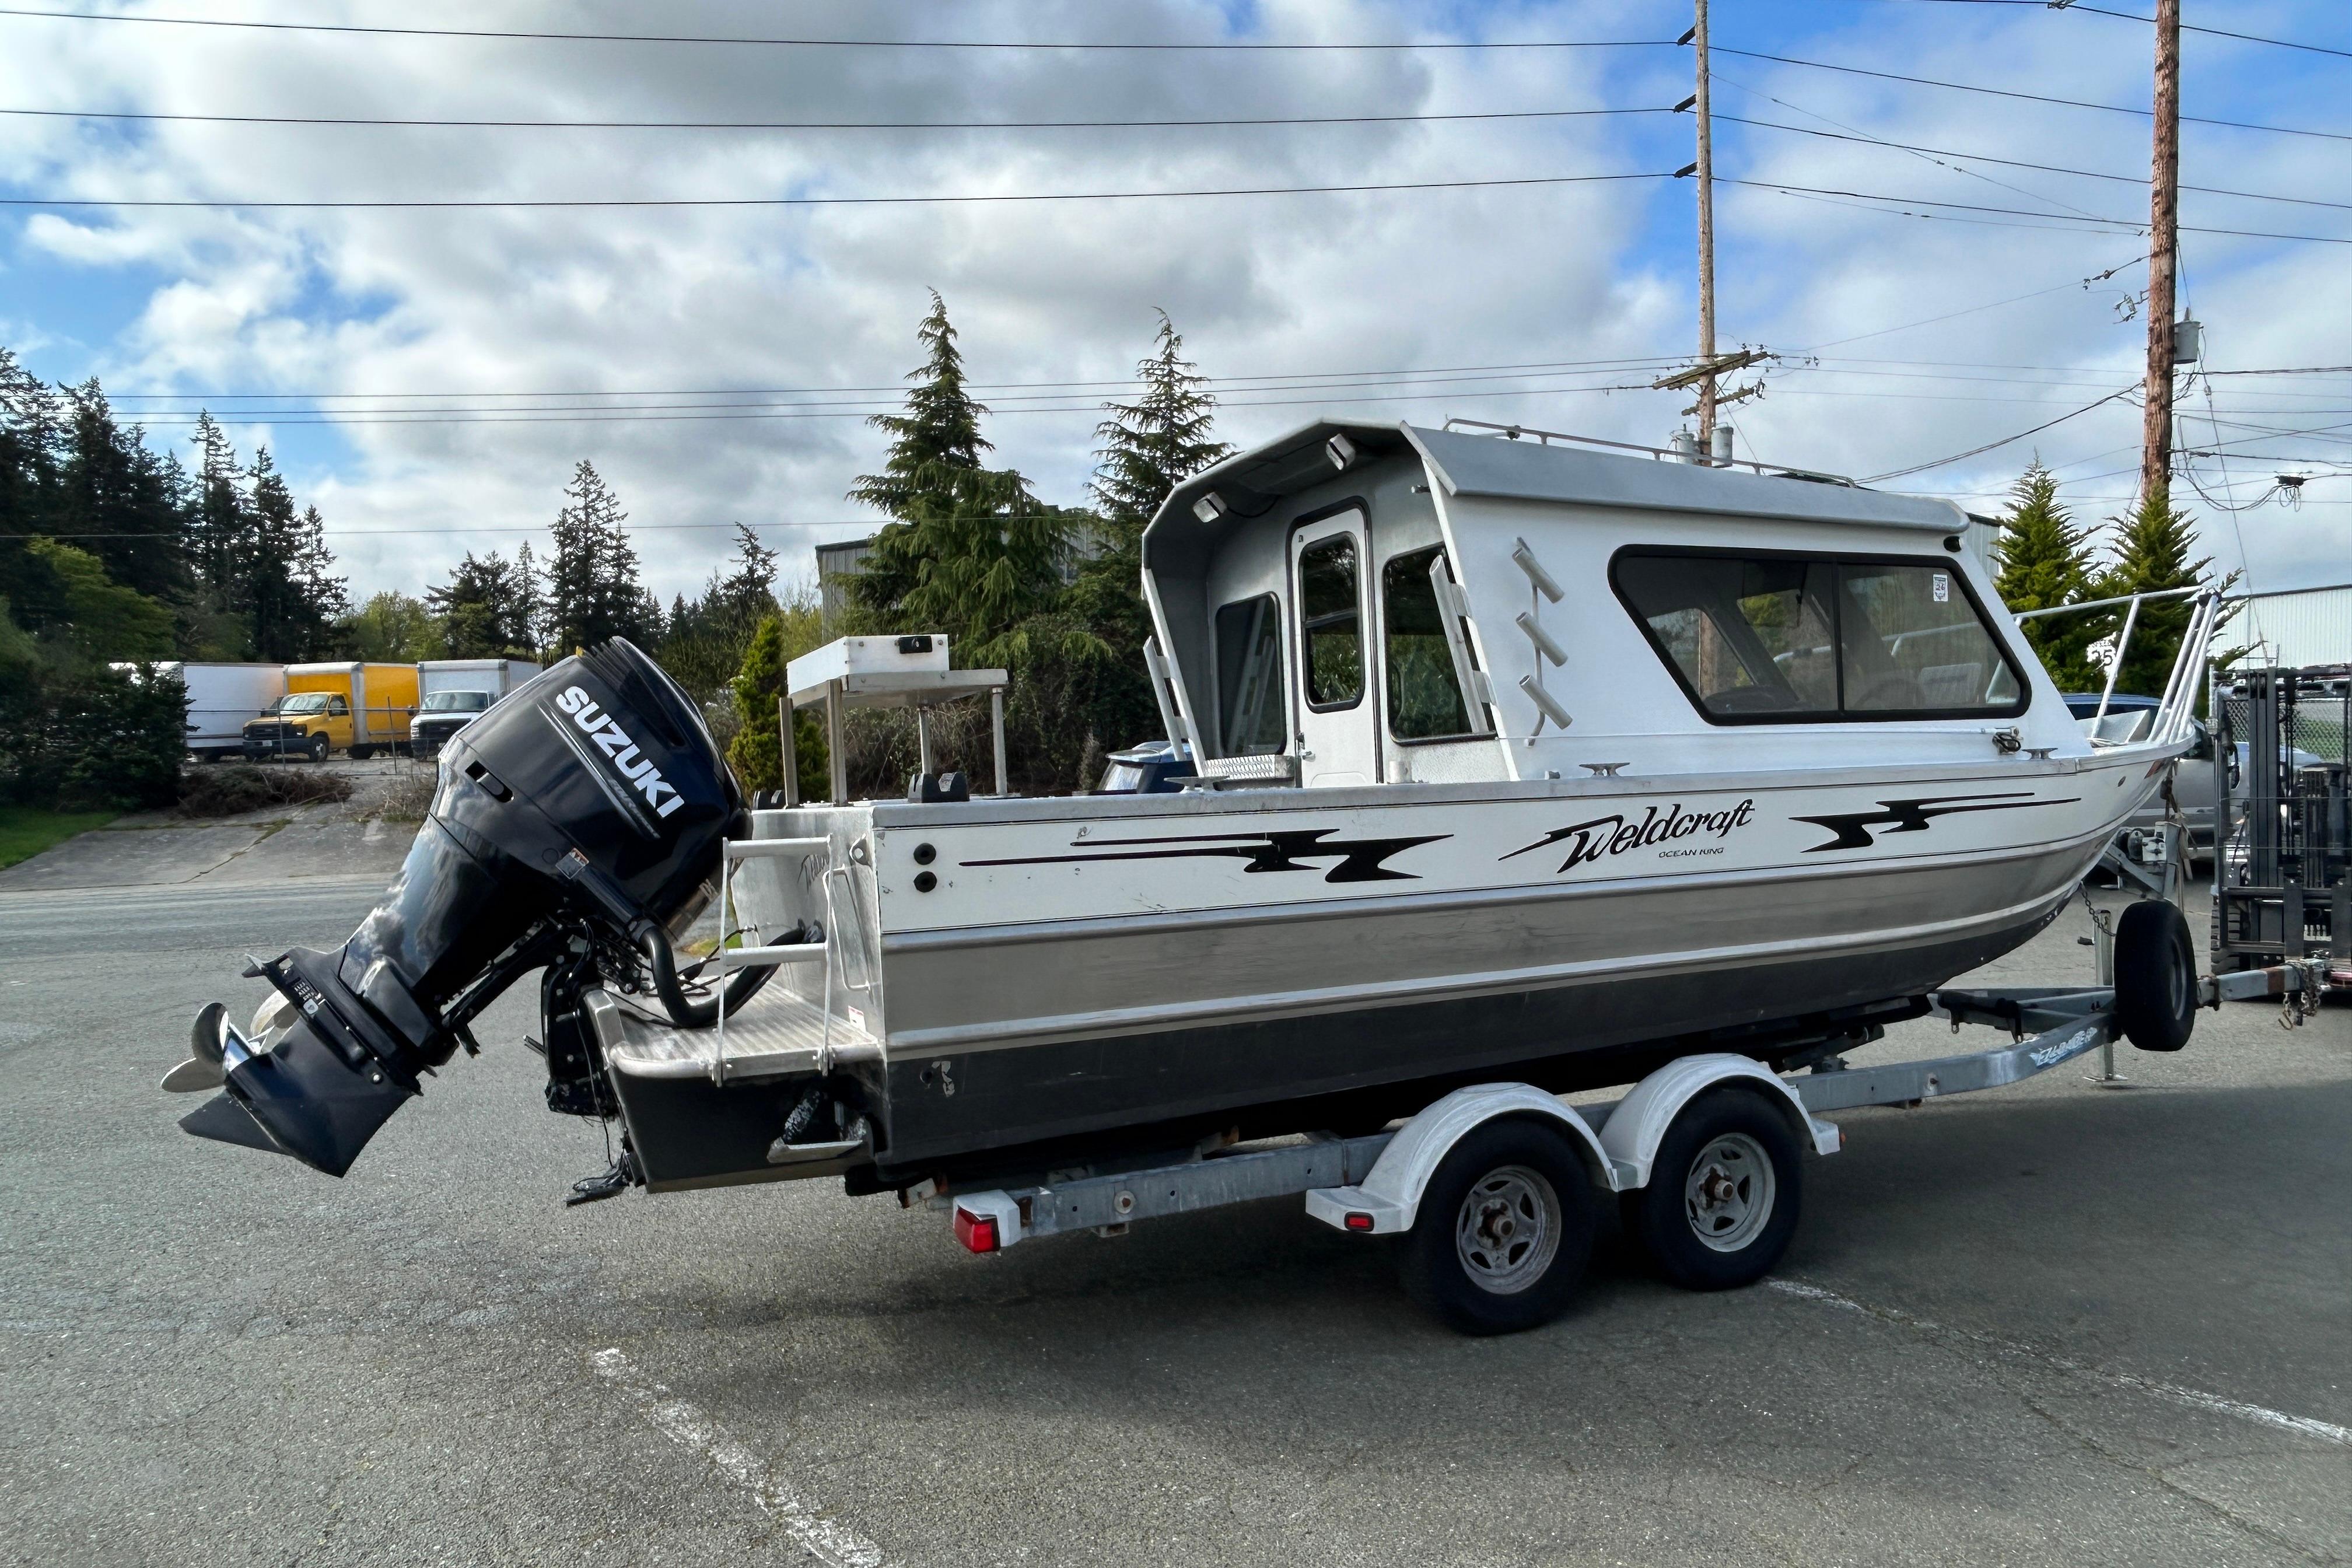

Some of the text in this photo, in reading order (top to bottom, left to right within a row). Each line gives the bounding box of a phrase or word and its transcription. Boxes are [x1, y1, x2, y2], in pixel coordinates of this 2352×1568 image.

[556, 685, 685, 818] SUZUKI
[1498, 799, 1755, 874] Weldcraft
[1658, 849, 1697, 858] OCEAN
